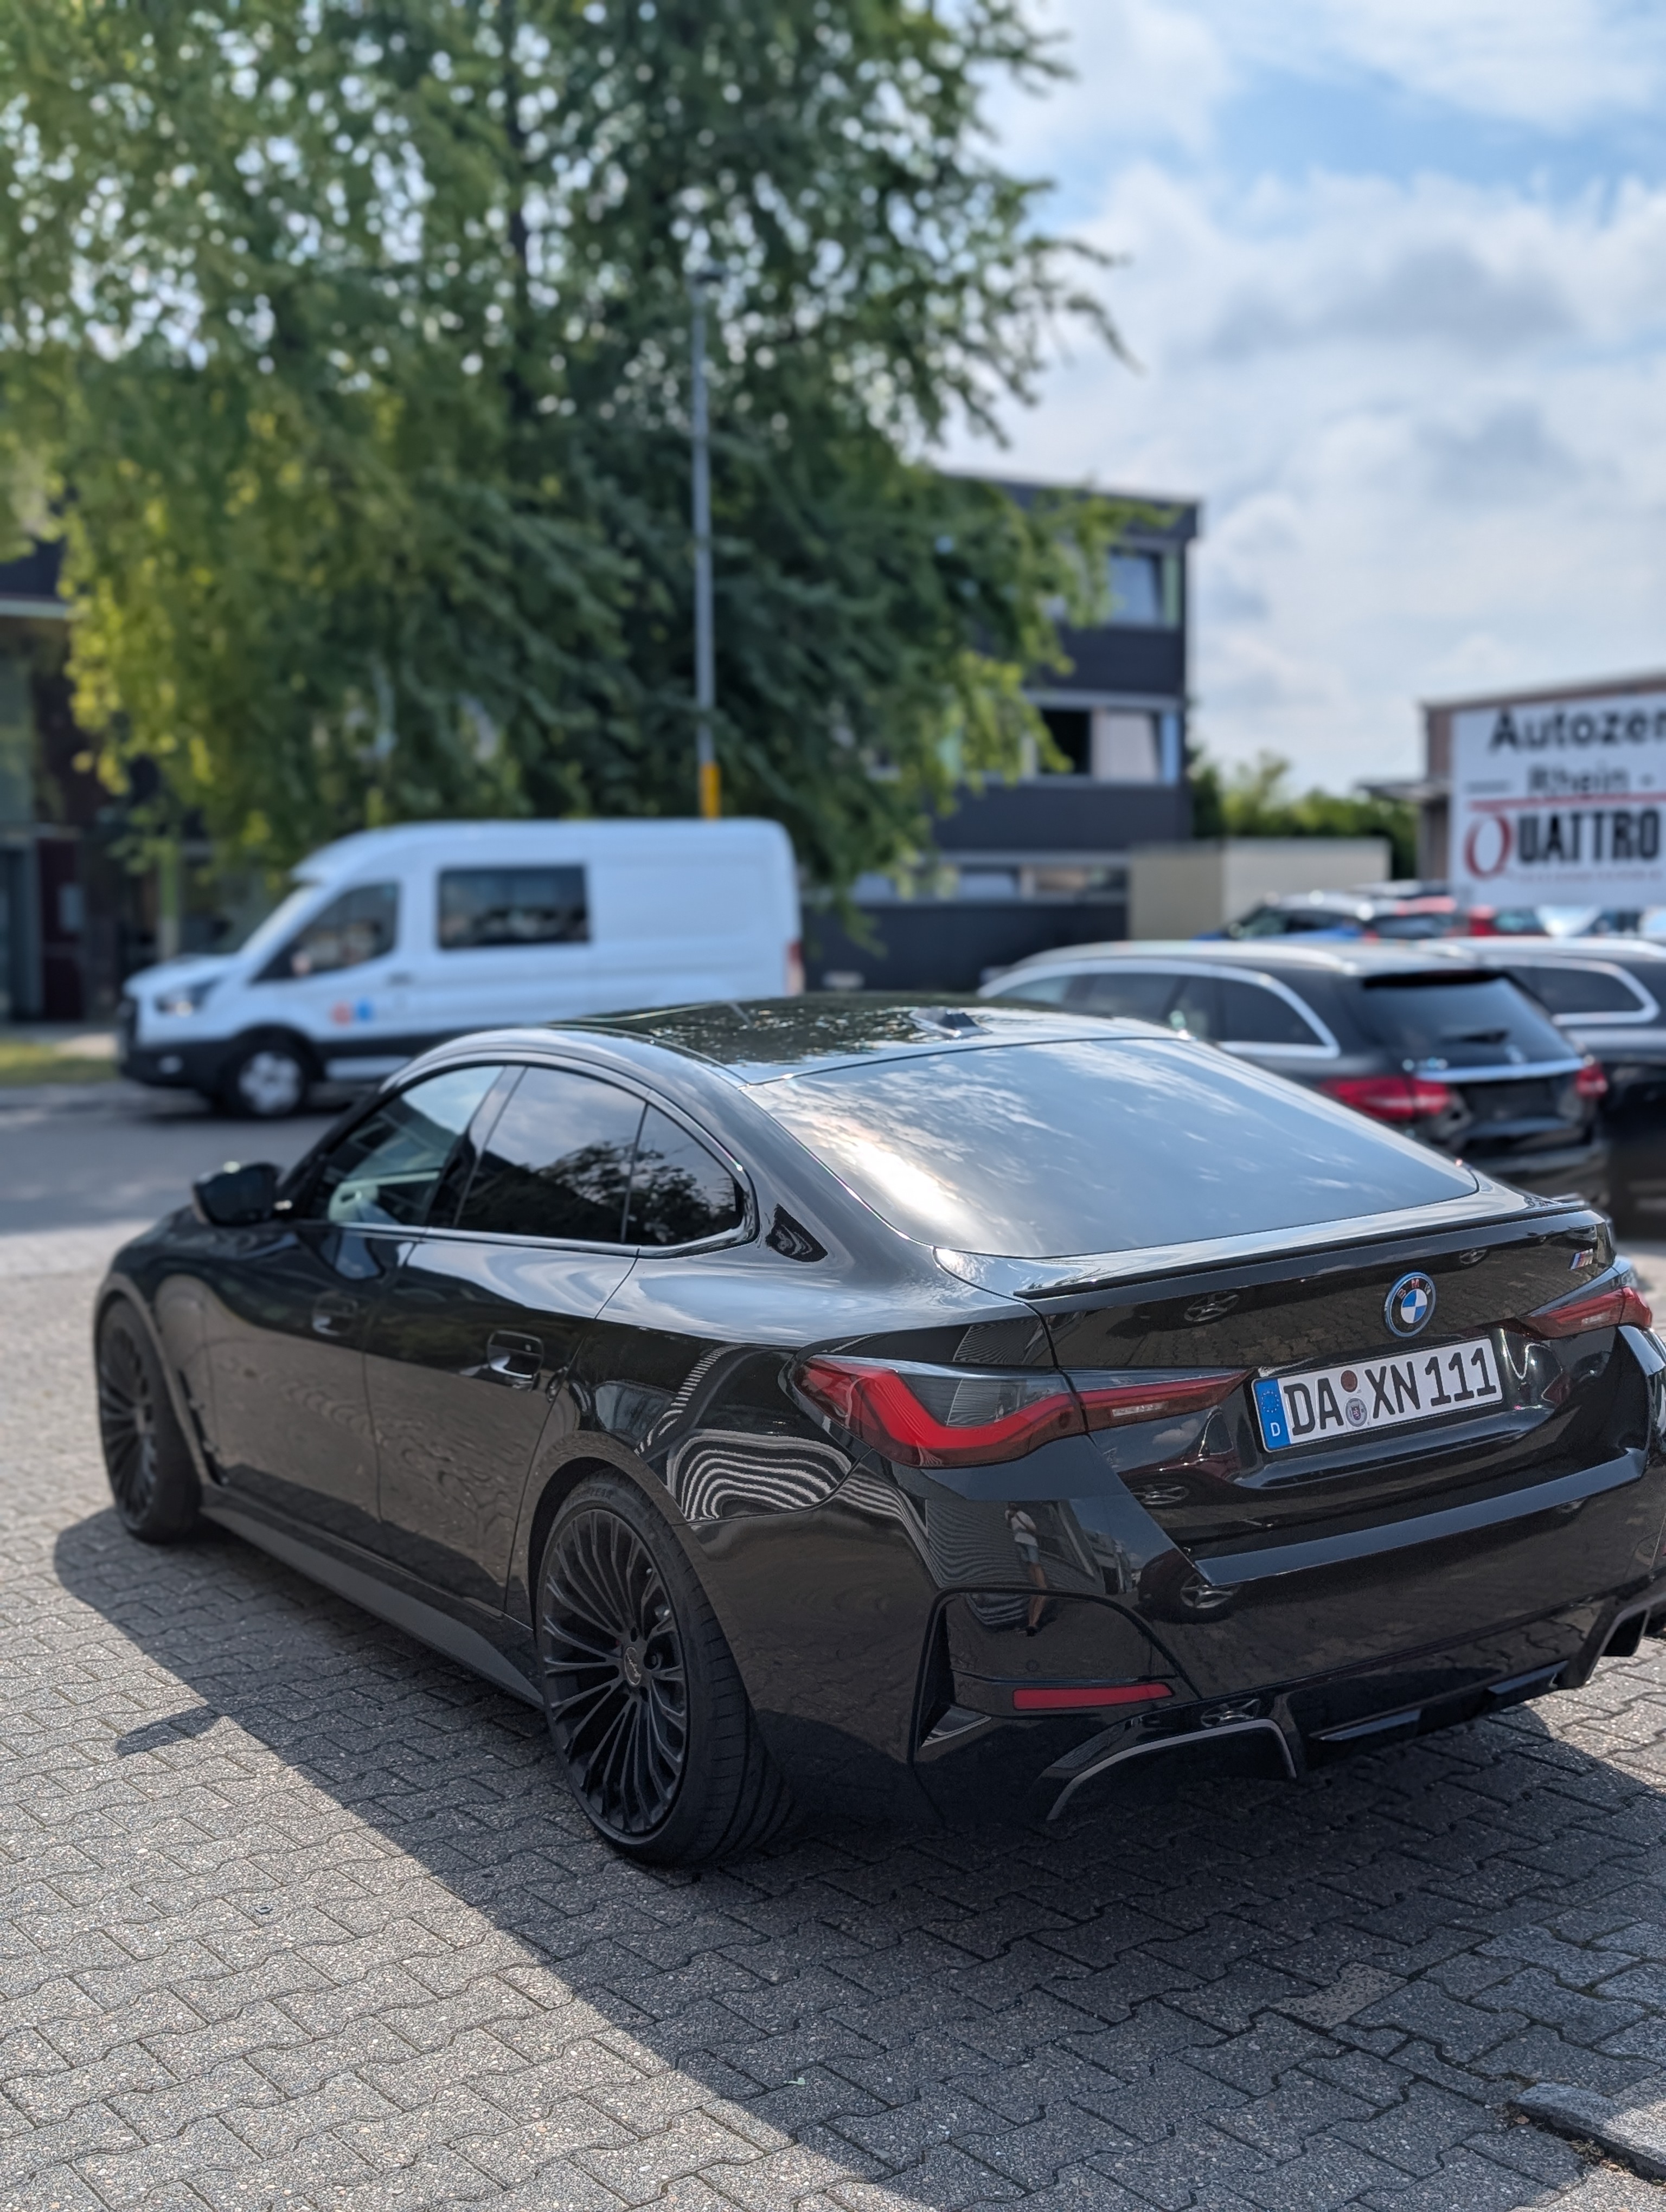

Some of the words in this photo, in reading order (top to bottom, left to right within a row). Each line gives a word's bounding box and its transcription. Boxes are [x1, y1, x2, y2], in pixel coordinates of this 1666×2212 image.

[1396, 1278, 1432, 1300] BMW
[1270, 1422, 1281, 1437] D
[1283, 1377, 1344, 1436] DA
[1364, 1361, 1421, 1419] XN
[1425, 1347, 1497, 1406] 111
